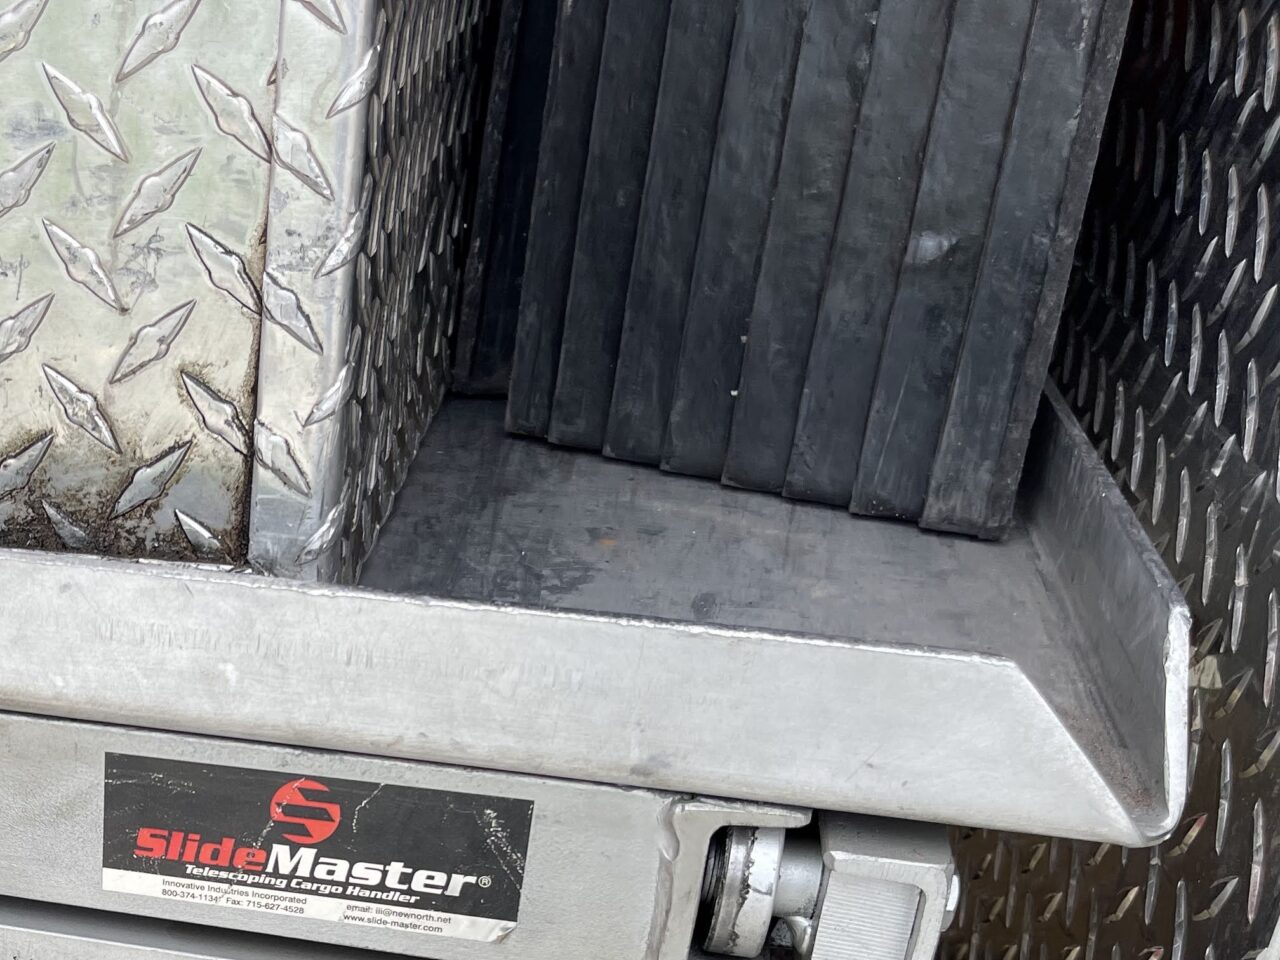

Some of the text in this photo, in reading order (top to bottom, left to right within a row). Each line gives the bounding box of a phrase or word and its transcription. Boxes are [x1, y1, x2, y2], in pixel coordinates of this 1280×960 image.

[162, 878, 308, 905] Innovative Industries Incorporated
[185, 864, 421, 904] Telescoping Cargo Handler
[246, 900, 305, 914] 715-627-4528
[346, 904, 452, 924] email: iii@newnorth.net
[343, 914, 443, 933] www.slide-master.com
